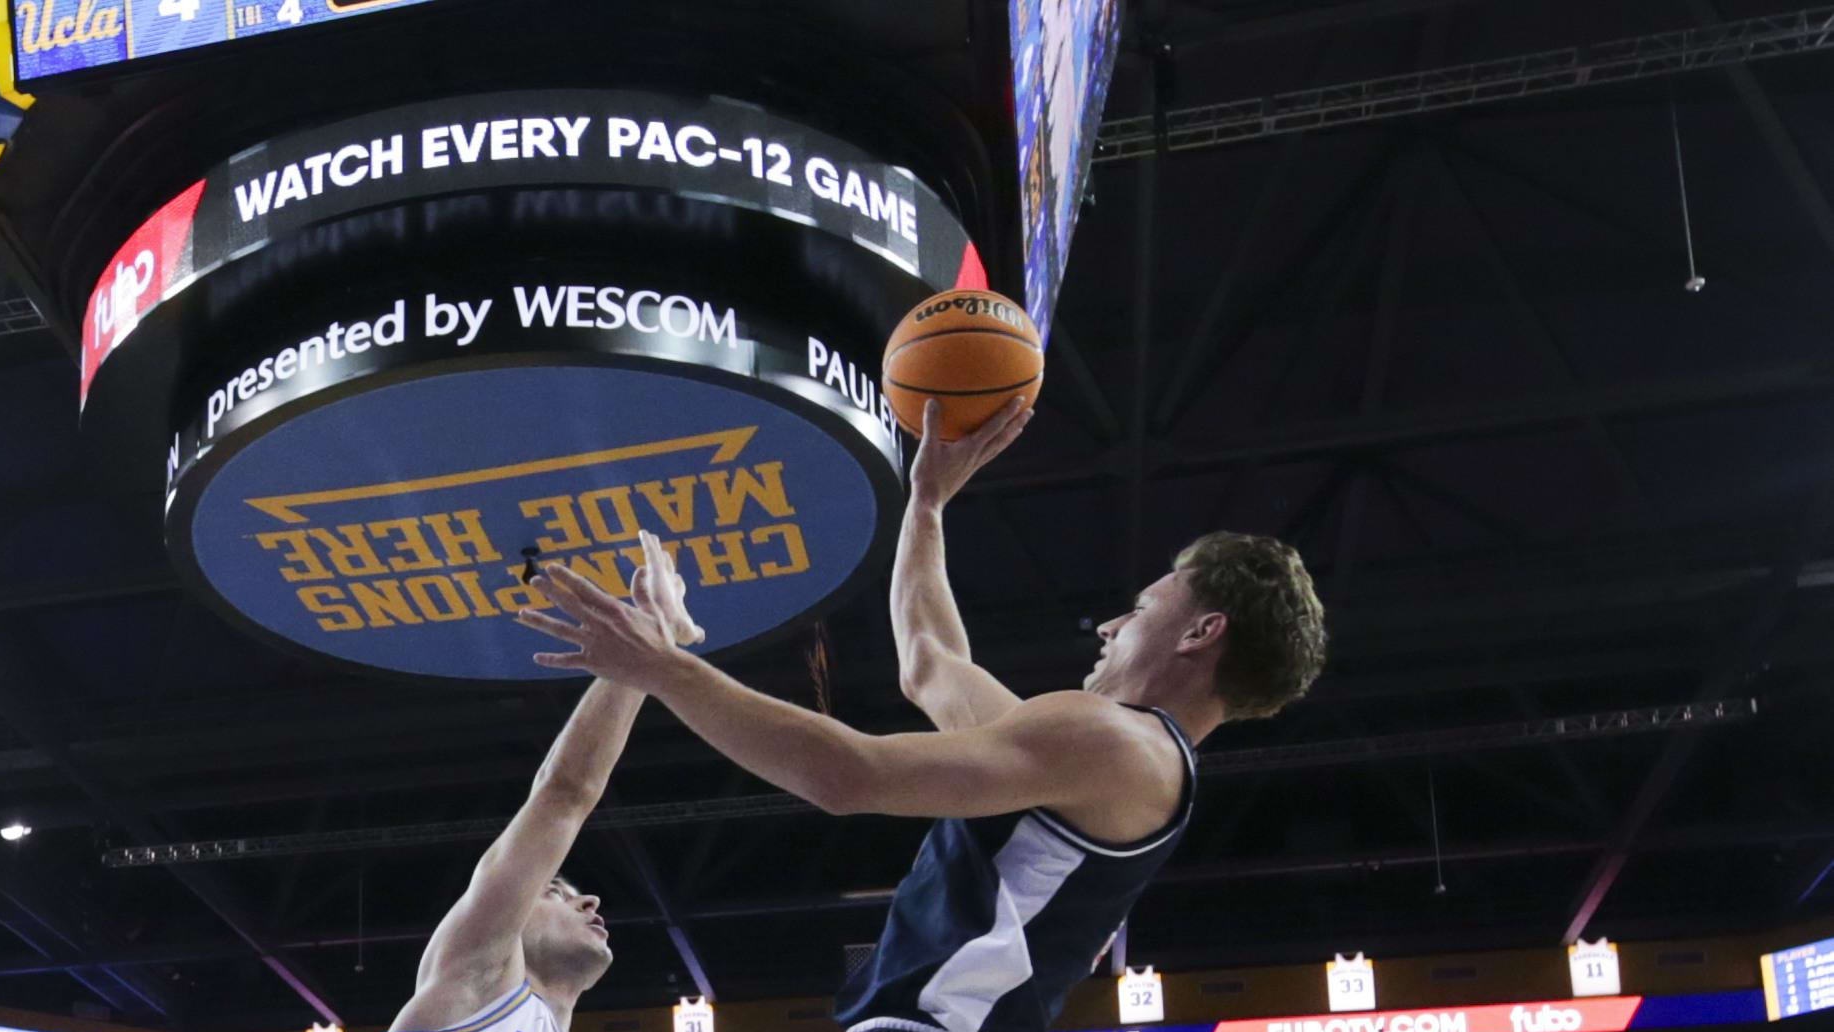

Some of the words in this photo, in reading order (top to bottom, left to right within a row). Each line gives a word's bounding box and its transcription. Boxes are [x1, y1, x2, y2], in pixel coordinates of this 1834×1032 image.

[17, 1, 123, 54] Ucla
[235, 135, 402, 222] WATCH
[420, 115, 591, 169] EVERY
[608, 119, 792, 186] PAC-12
[805, 157, 919, 244] GAME
[916, 296, 1025, 331] Wilson
[208, 301, 406, 436] presented
[424, 293, 493, 346] by
[514, 286, 739, 348] WESCOM
[808, 335, 897, 449] PAULEY
[519, 459, 796, 553] MADE
[253, 508, 503, 582] HERE
[1130, 991, 1154, 1007] 32
[1340, 978, 1364, 994] 33
[1586, 962, 1604, 978] 11
